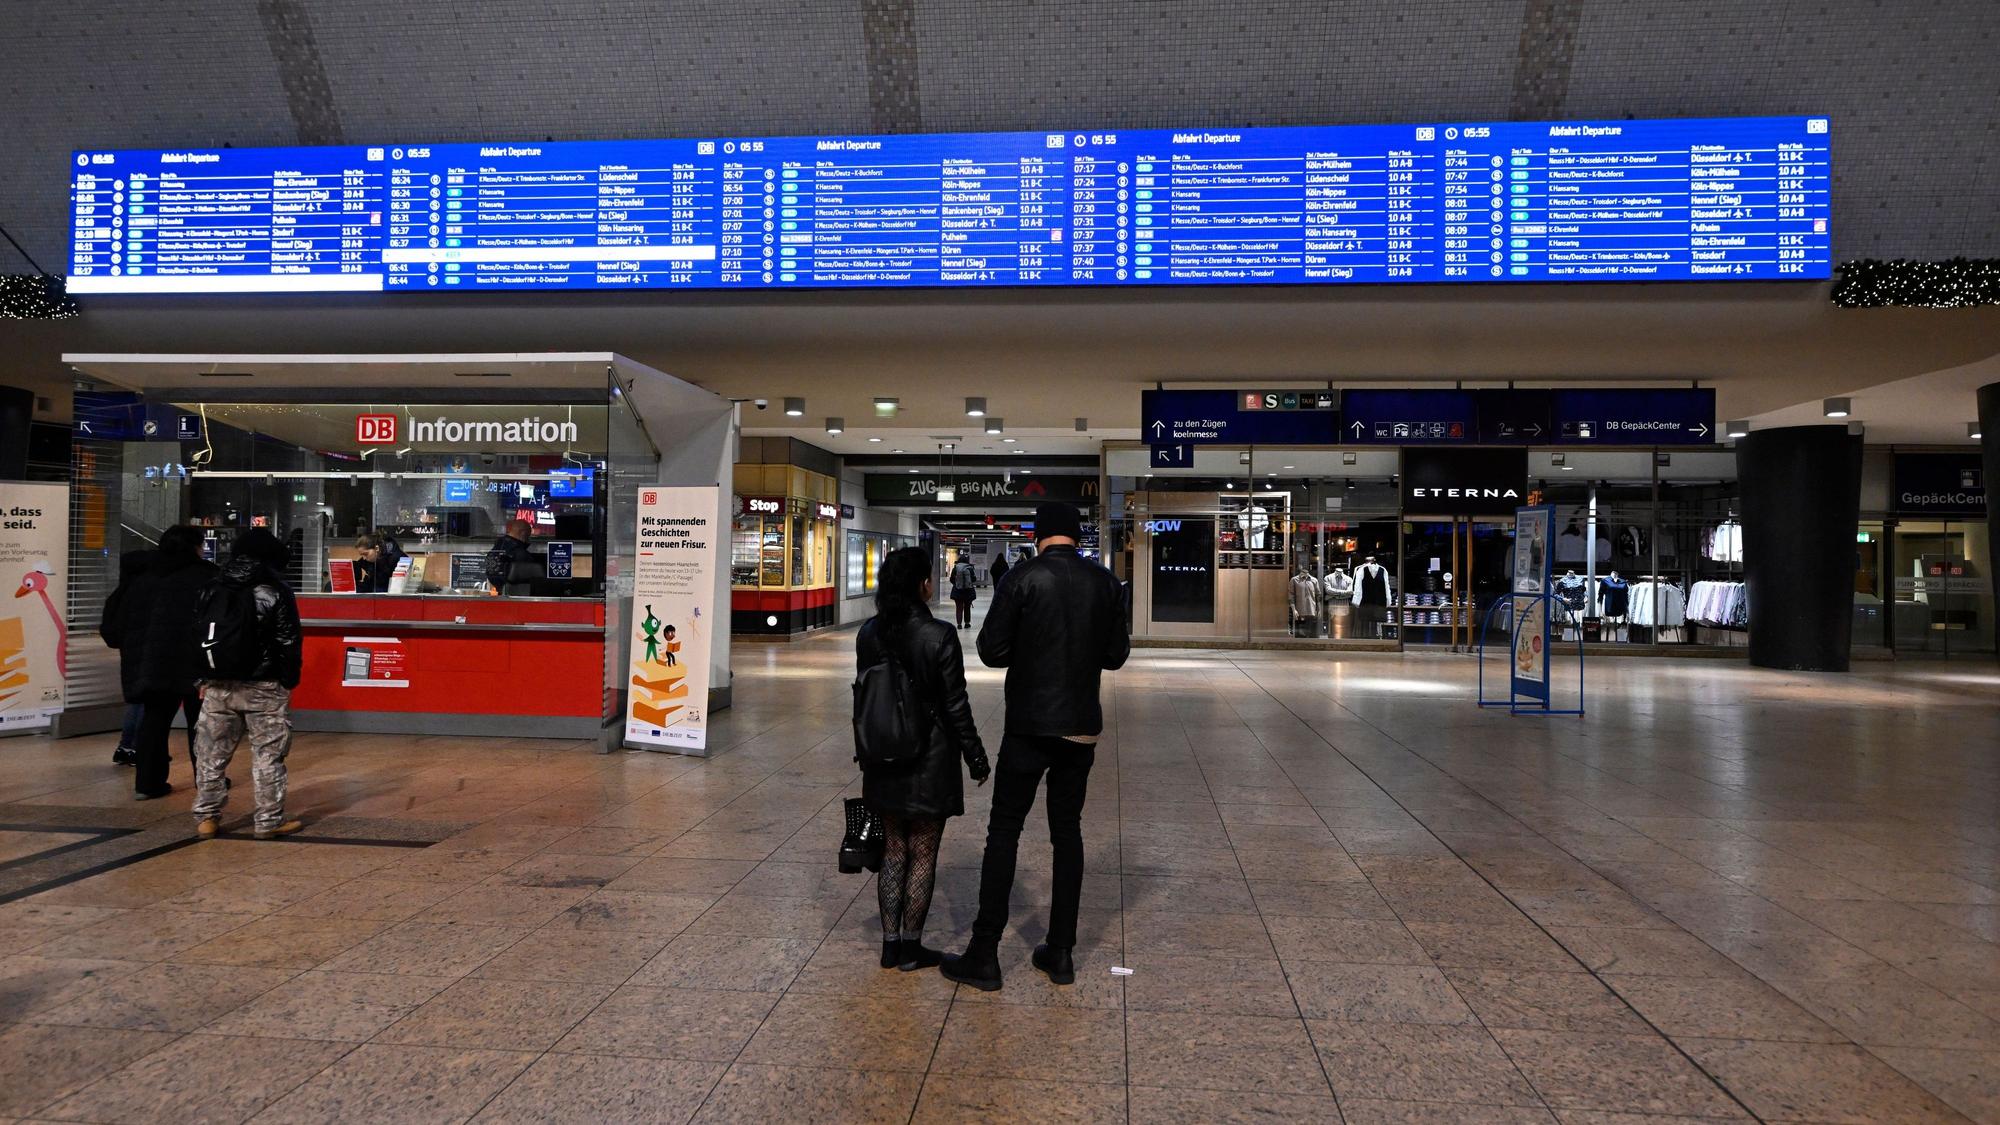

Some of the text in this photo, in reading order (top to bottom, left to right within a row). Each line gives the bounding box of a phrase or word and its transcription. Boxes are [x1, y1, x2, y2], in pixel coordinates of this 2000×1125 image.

[1463, 128, 1490, 138] 05:55
[1549, 125, 1622, 136] Abfahrt Departure
[1172, 132, 1240, 143] Abfahrt Departure
[816, 140, 881, 151] Abfahrt Departure
[480, 146, 541, 157] Abfahrt Departure
[1305, 160, 1351, 169] Köln-Mülheim
[1445, 158, 1467, 167] 07:44
[1073, 164, 1095, 173] 07:17
[723, 170, 743, 179] 06:47
[1305, 174, 1349, 182] Lüdenscheid
[1445, 172, 1467, 180] 07:47
[1073, 178, 1095, 186] 07:24
[723, 183, 743, 192] 06:54
[1445, 185, 1467, 194] 07:54
[1073, 191, 1094, 199] 07:24
[1305, 187, 1346, 198] Köln-Nippes
[722, 196, 743, 204] 07:00
[1444, 199, 1467, 208] 08:01
[1073, 204, 1094, 213] 07:30
[1305, 201, 1356, 209] Köln-Ehrenfeld
[722, 209, 742, 218] 07:01
[1444, 213, 1467, 221] 08:07
[1073, 217, 1094, 226] 07:31
[1305, 214, 1337, 224] Au (Sieg)
[722, 222, 742, 230] 07:07
[1444, 226, 1467, 235] 08:09
[1073, 230, 1094, 239] 07:37
[1305, 228, 1356, 238] Köln Hansaring
[722, 235, 742, 243] 07:09
[1072, 244, 1094, 252] 07:37
[1305, 241, 1362, 250] Düsseldorf T.
[1444, 240, 1467, 248] 08:10
[721, 248, 742, 256] 07:10
[1072, 257, 1094, 266] 07:40
[1305, 255, 1326, 264] Düren
[1444, 254, 1467, 262] 08:11
[721, 261, 741, 269] 07:11
[1072, 270, 1093, 279] 07:41
[1305, 268, 1352, 278] Hennef (Sieg)
[1444, 267, 1467, 276] 08:14
[721, 274, 741, 282] 07:14
[1202, 419, 1227, 429] Zügen
[1606, 421, 1680, 431] DB GepäckCenter
[359, 417, 577, 442] DB Information
[1173, 430, 1218, 438] koelnmesse
[1176, 445, 1182, 461] 1
[909, 480, 936, 496] ZUG
[1414, 488, 1518, 498] ETERNA
[644, 493, 656, 504] DB
[750, 499, 779, 513] Stop
[10, 506, 42, 516] dass
[4, 519, 36, 529] seid.
[642, 517, 706, 527] Mit spannenden
[641, 528, 690, 537] Geschichten
[682, 540, 706, 549] Frisur.
